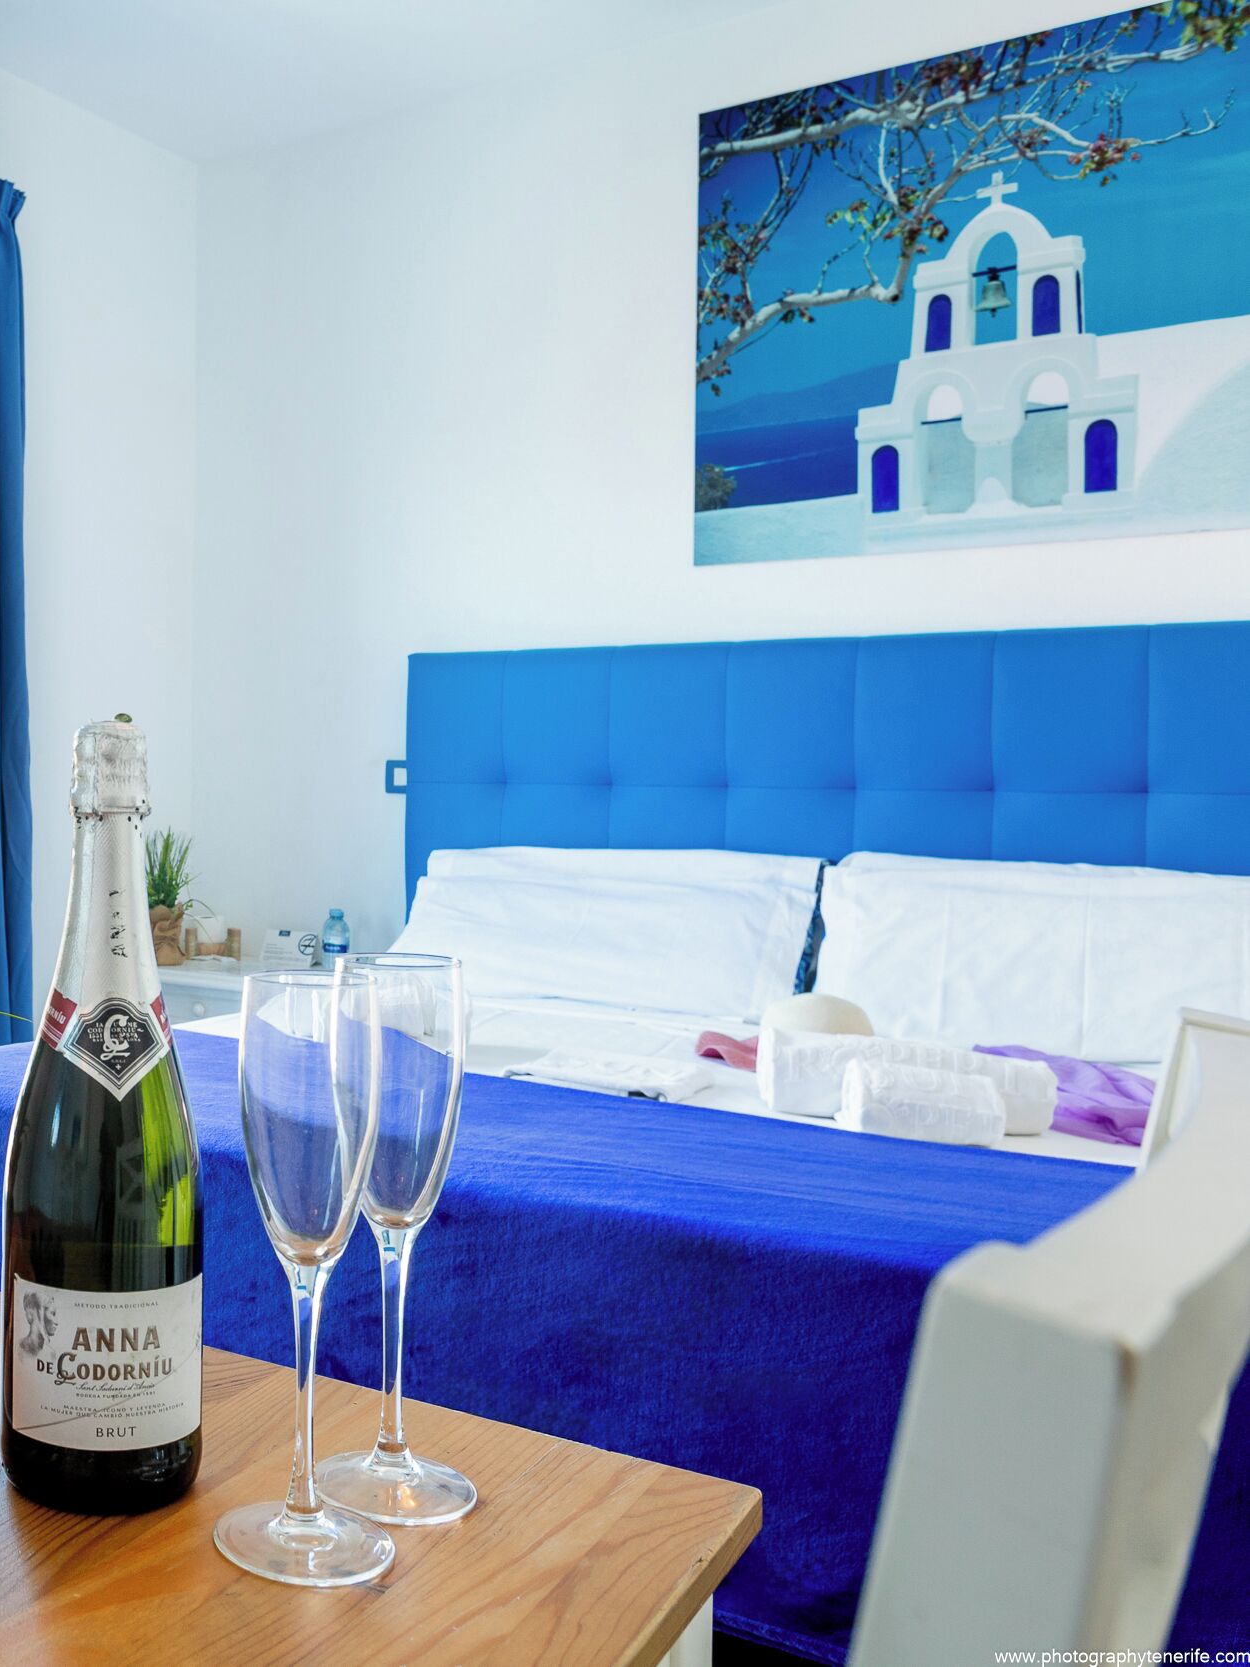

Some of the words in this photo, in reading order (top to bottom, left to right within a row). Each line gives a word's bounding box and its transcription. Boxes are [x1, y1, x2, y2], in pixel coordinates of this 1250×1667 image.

[110, 1301, 159, 1309] TRADICIONAL
[71, 1326, 161, 1352] ANNA
[36, 1358, 54, 1375] DE
[51, 1407, 73, 1415] MUJER
[96, 1426, 138, 1438] BRUT
